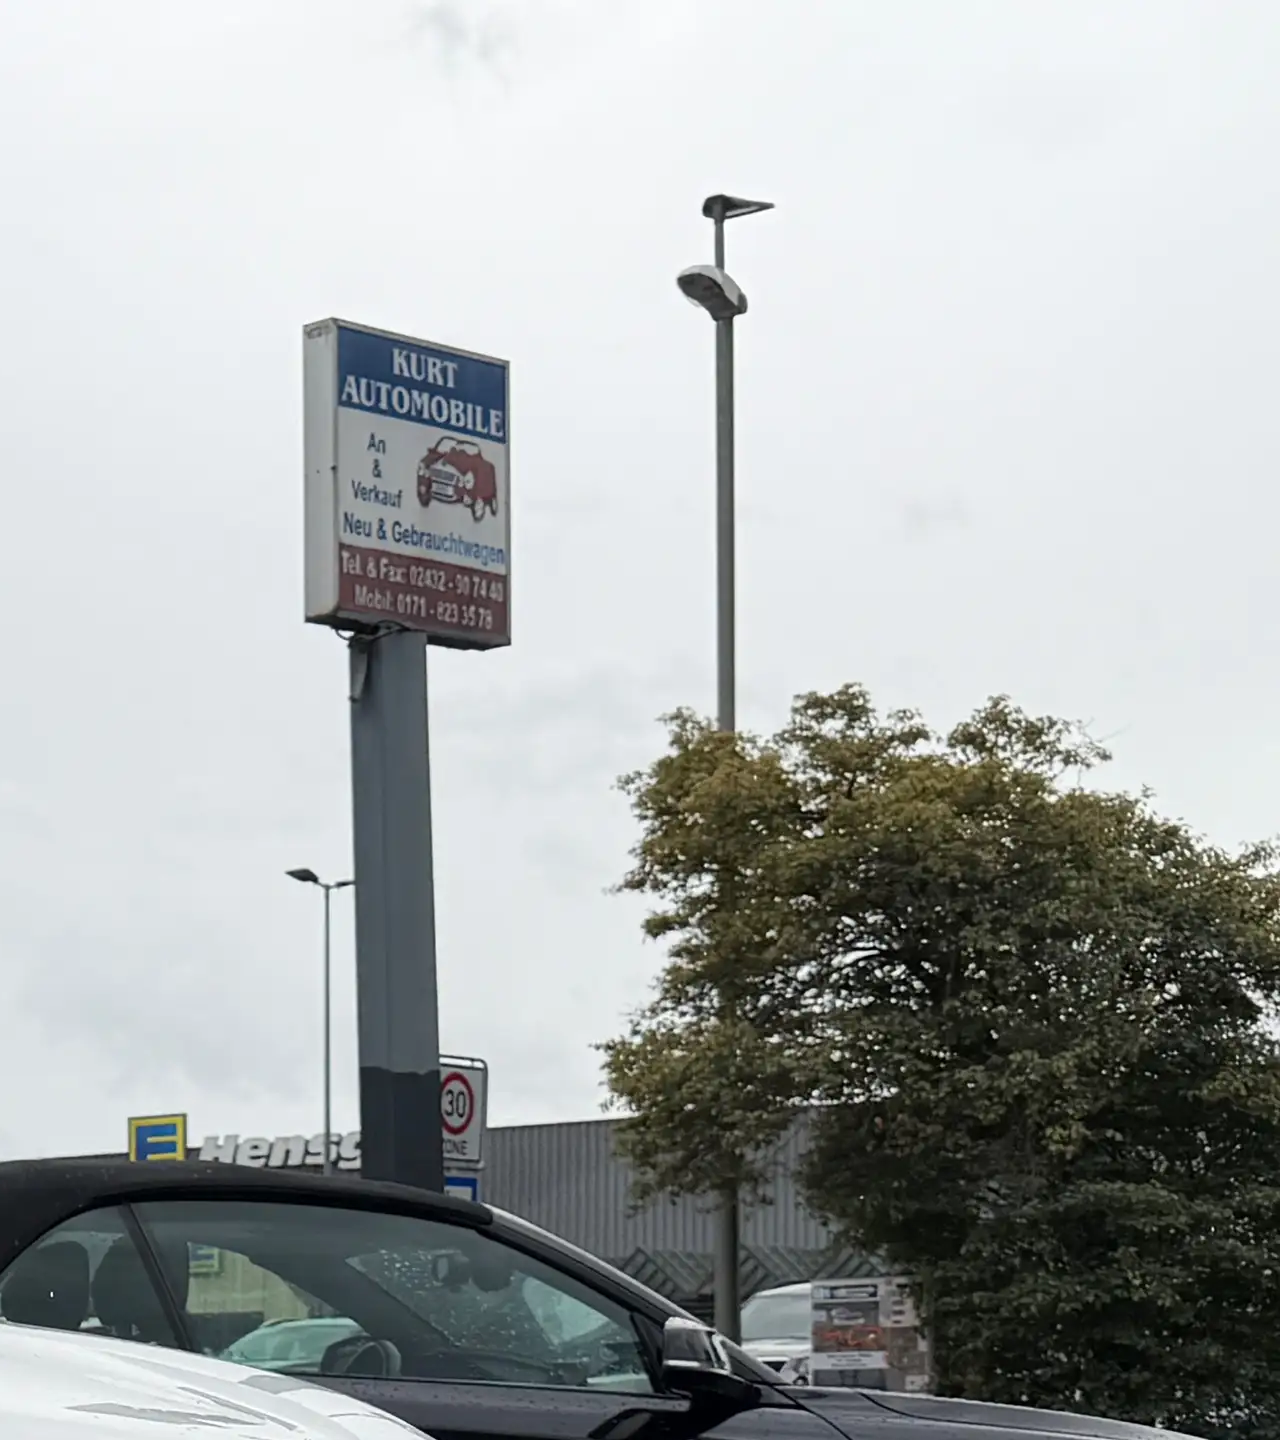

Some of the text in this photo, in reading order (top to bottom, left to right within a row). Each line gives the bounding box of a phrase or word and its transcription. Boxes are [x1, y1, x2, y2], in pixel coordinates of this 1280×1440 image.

[392, 348, 458, 388] KURT
[341, 374, 504, 437] AUTOMOBILE
[367, 432, 386, 456] An
[371, 459, 382, 478] &
[351, 479, 403, 509] Verkauf
[343, 511, 505, 566] Neu & Gebrauchtwagen
[366, 556, 377, 579] &
[397, 593, 427, 618] 0171
[444, 1089, 466, 1118] 30
[443, 1138, 468, 1157] ONE
